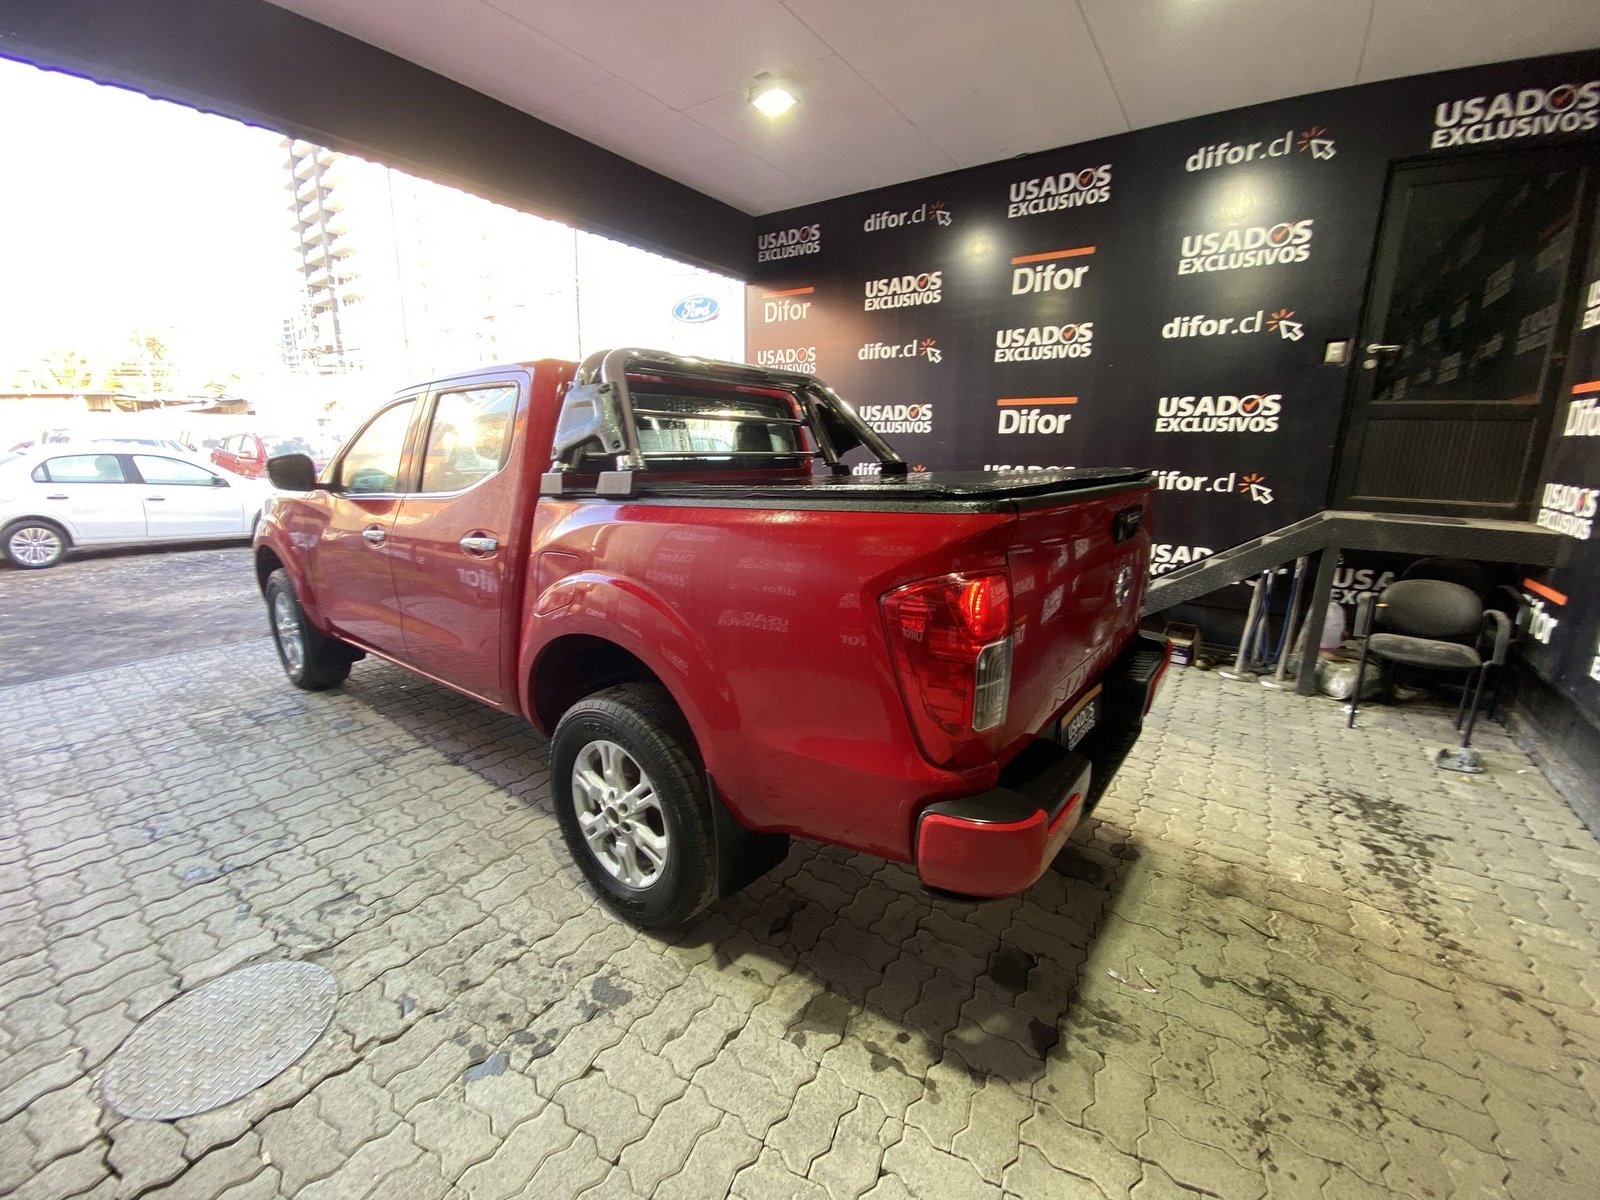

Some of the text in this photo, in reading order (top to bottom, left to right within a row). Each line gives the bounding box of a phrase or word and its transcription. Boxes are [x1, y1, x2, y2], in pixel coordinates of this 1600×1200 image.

[1435, 80, 1600, 128] USADOS
[1431, 109, 1599, 149] EXCLUSIVOS
[1185, 130, 1293, 173] difor.cl
[1009, 163, 1112, 202] USADOS
[1008, 186, 1111, 219] EXCLUSIVOS
[863, 203, 926, 233] difor.cl
[758, 223, 820, 250] USADOS
[1181, 219, 1314, 258] USADOS
[758, 241, 820, 263] EXCLUSIVOS
[1178, 244, 1311, 275] EXCLUSIVOS
[865, 271, 943, 298] USADOS
[1011, 264, 1089, 295] Difor
[764, 299, 811, 323] Difor
[864, 289, 942, 311] EXCLUSIVOS
[996, 322, 1093, 349] USADOS
[1161, 310, 1264, 339] difor.cl
[757, 346, 816, 365] USADOS
[858, 339, 918, 361] difor.cl
[994, 343, 1092, 362] EXCLUSIVOS
[859, 403, 933, 422] USADOS
[1157, 394, 1282, 418] USADOS
[866, 420, 933, 433] CLUSIVOS
[997, 409, 1072, 434] Difor
[1155, 416, 1279, 432] EXCLUSIVOS
[1151, 470, 1236, 492] ifor.cl
